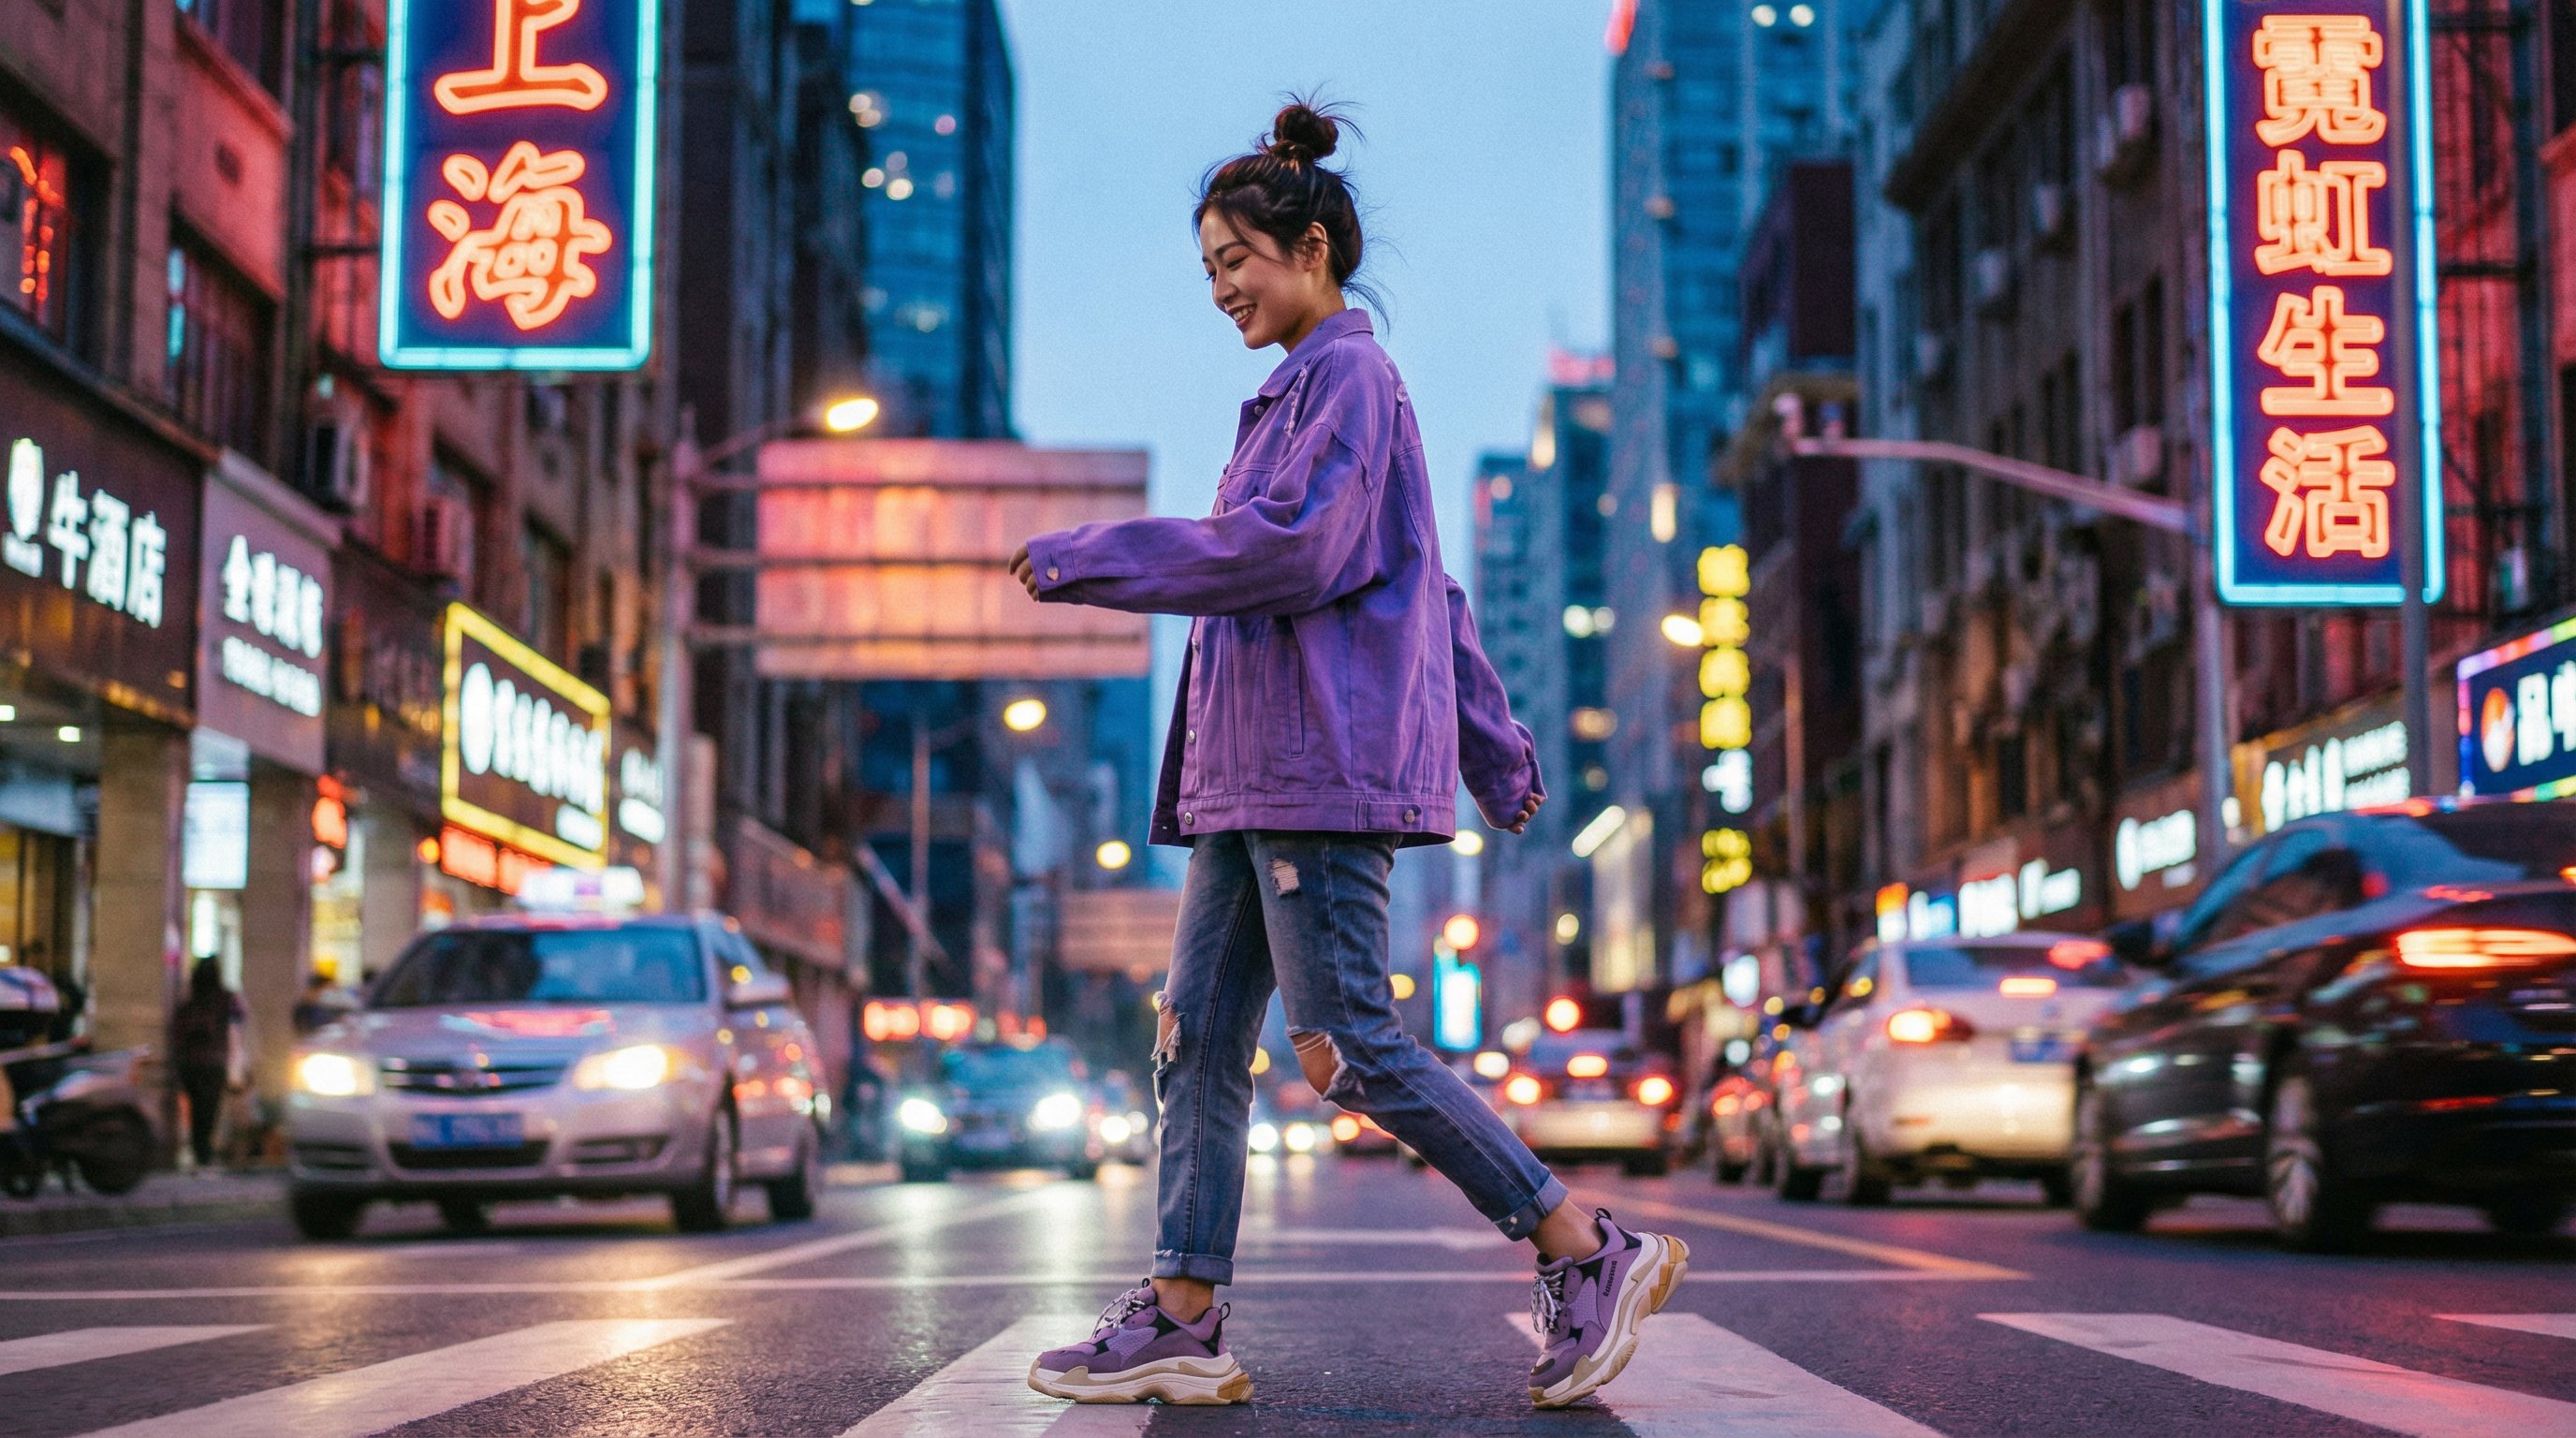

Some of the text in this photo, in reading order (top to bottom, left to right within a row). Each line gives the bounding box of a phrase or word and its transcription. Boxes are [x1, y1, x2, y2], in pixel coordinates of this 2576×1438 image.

[428, 0, 612, 330] 上海
[2252, 14, 2396, 559] 霓虹生活
